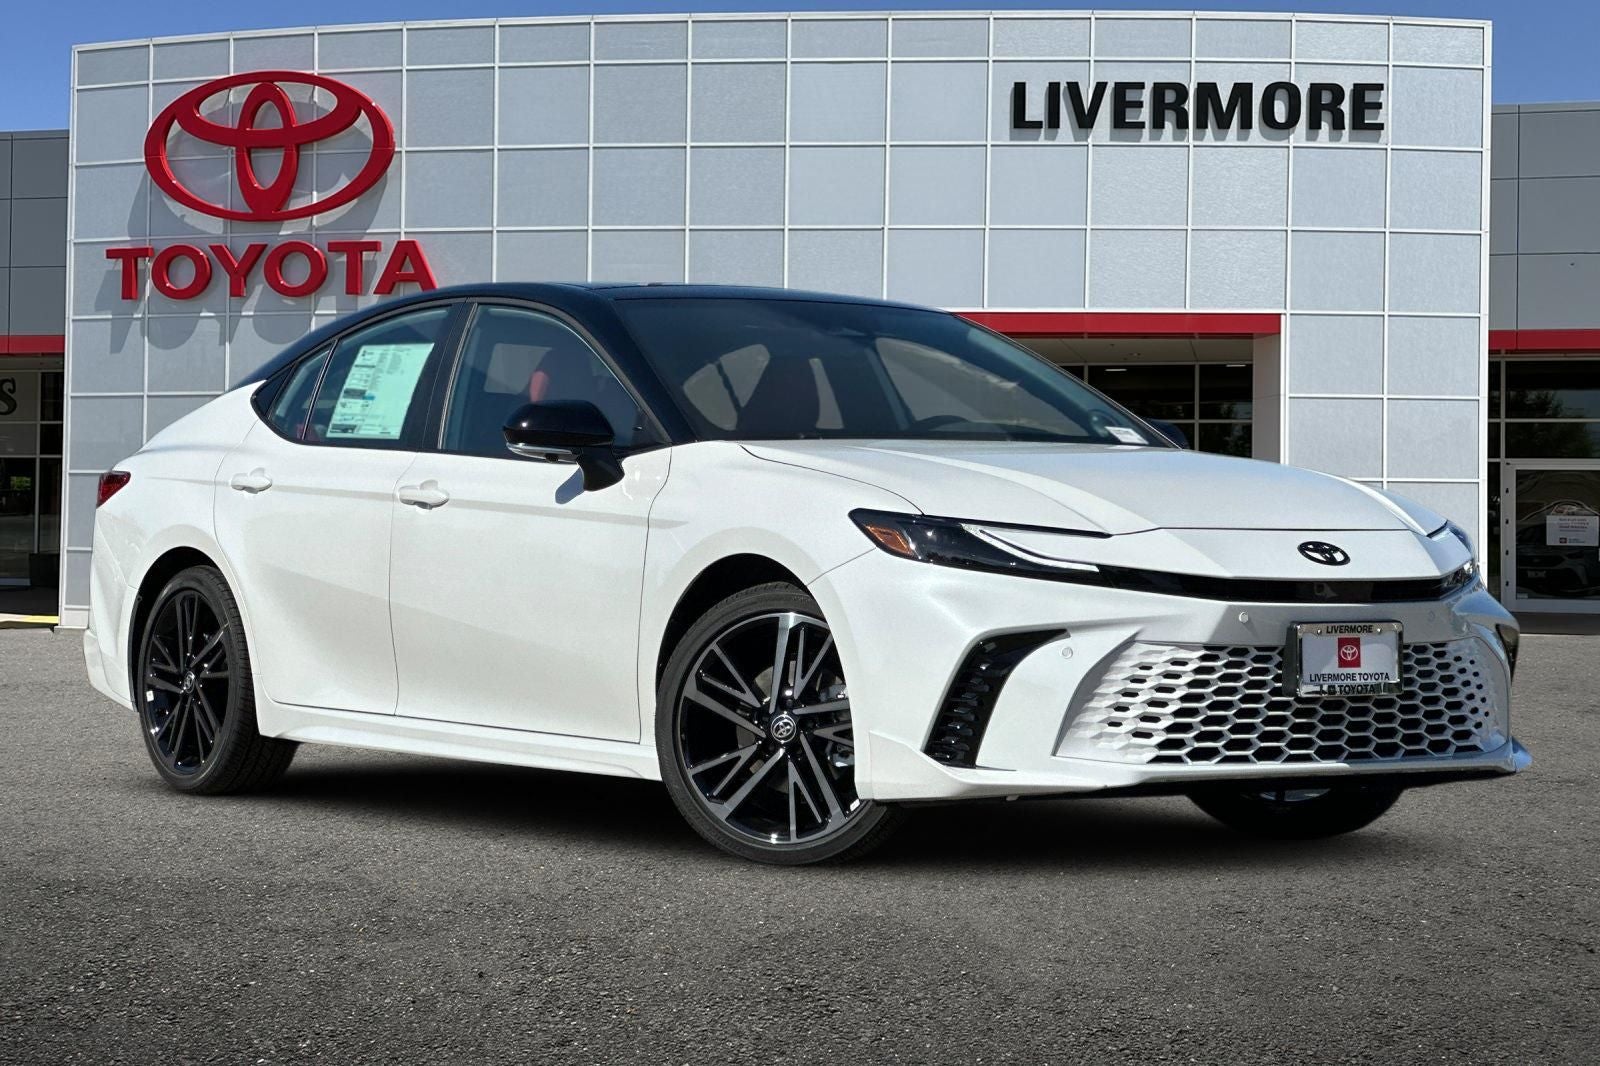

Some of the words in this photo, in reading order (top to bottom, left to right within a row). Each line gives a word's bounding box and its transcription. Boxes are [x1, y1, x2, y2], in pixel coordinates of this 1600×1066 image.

[1012, 81, 1385, 131] LIVERMORE
[106, 239, 438, 301] TOYOTA
[1326, 624, 1374, 634] LIVERMORE
[1309, 672, 1357, 682] LIVERMORE
[1358, 672, 1390, 681] TOYOTA
[1338, 684, 1375, 695] TOYOTA
